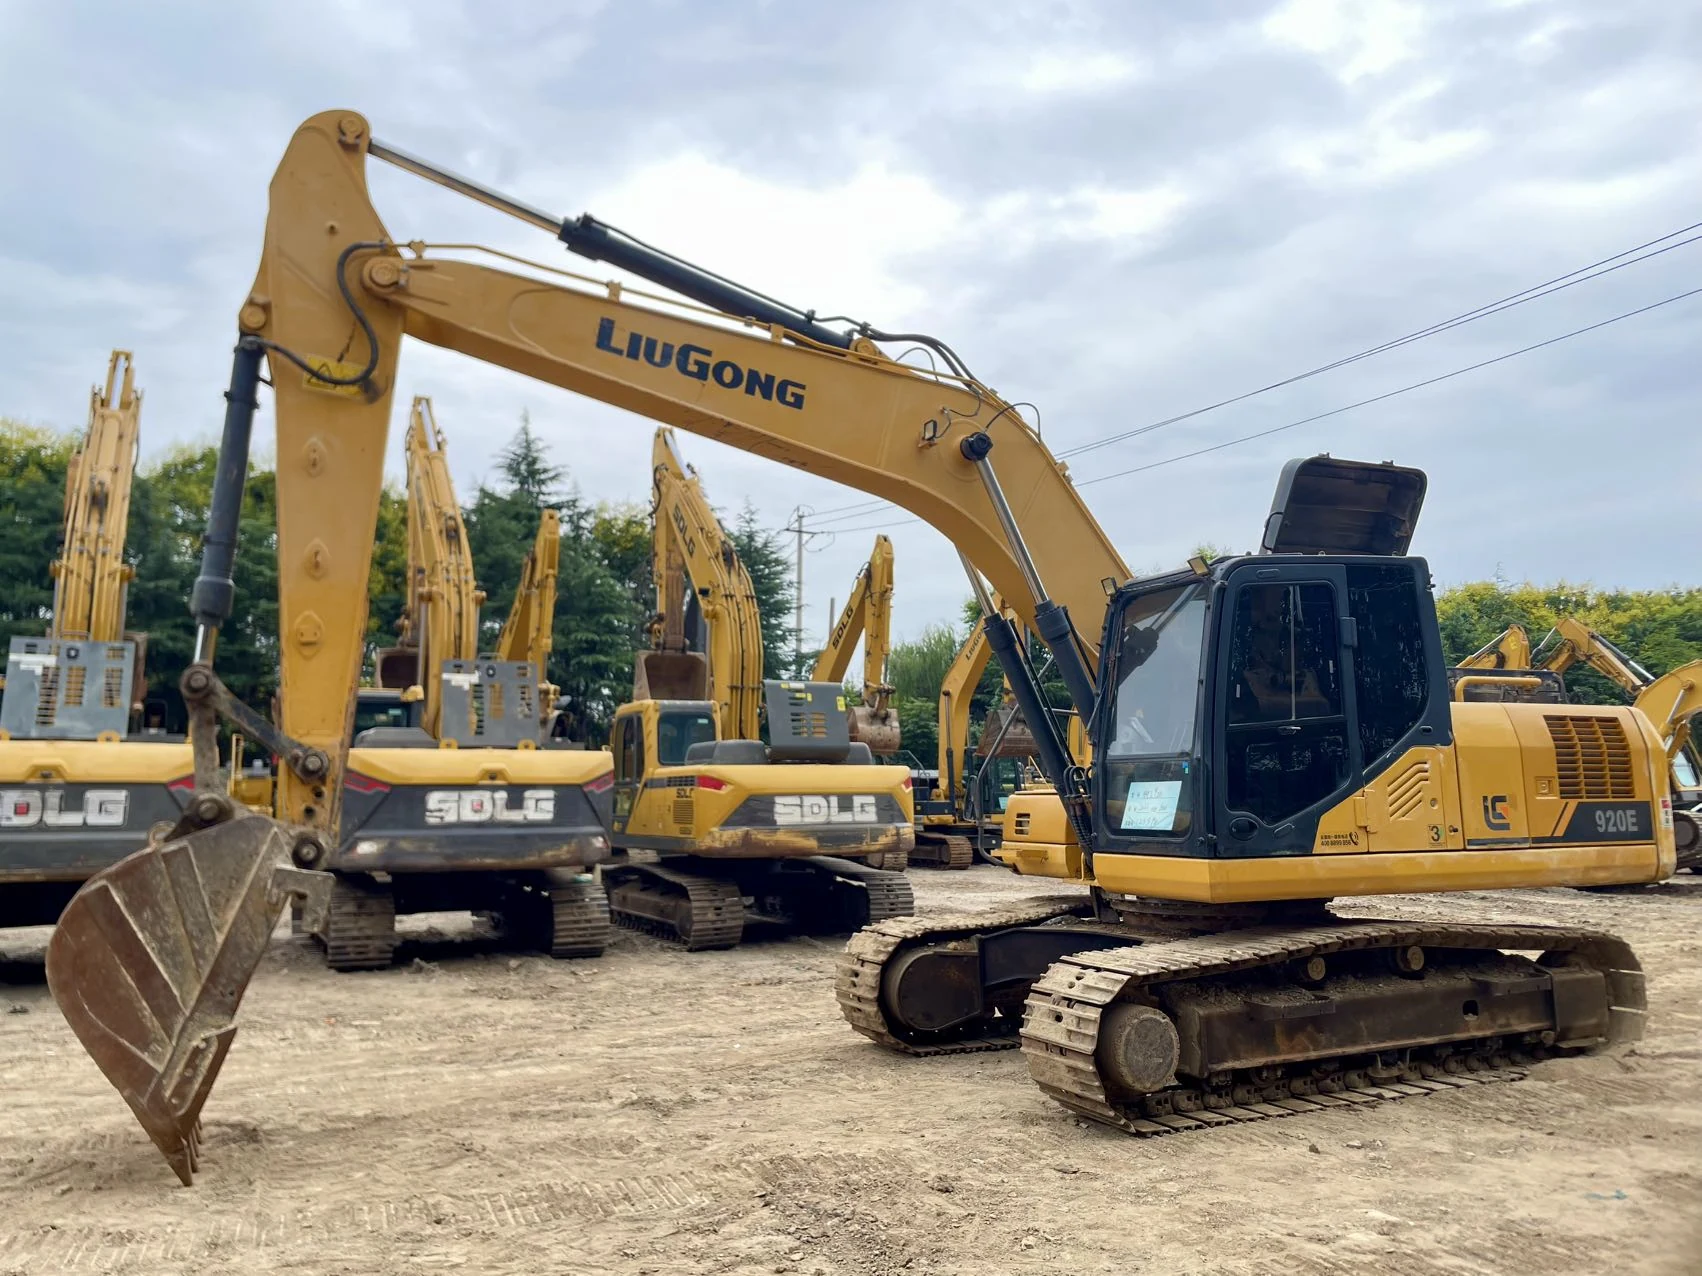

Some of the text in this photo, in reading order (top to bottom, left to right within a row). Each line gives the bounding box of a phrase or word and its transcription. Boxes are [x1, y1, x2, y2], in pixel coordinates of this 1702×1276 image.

[673, 503, 696, 559] SDLG
[832, 605, 853, 650] SDLG
[0, 789, 128, 827] DLG
[424, 789, 555, 824] SDLG
[773, 795, 878, 825] SDLG
[1595, 809, 1638, 833] 920E
[1430, 825, 1440, 842] 3
